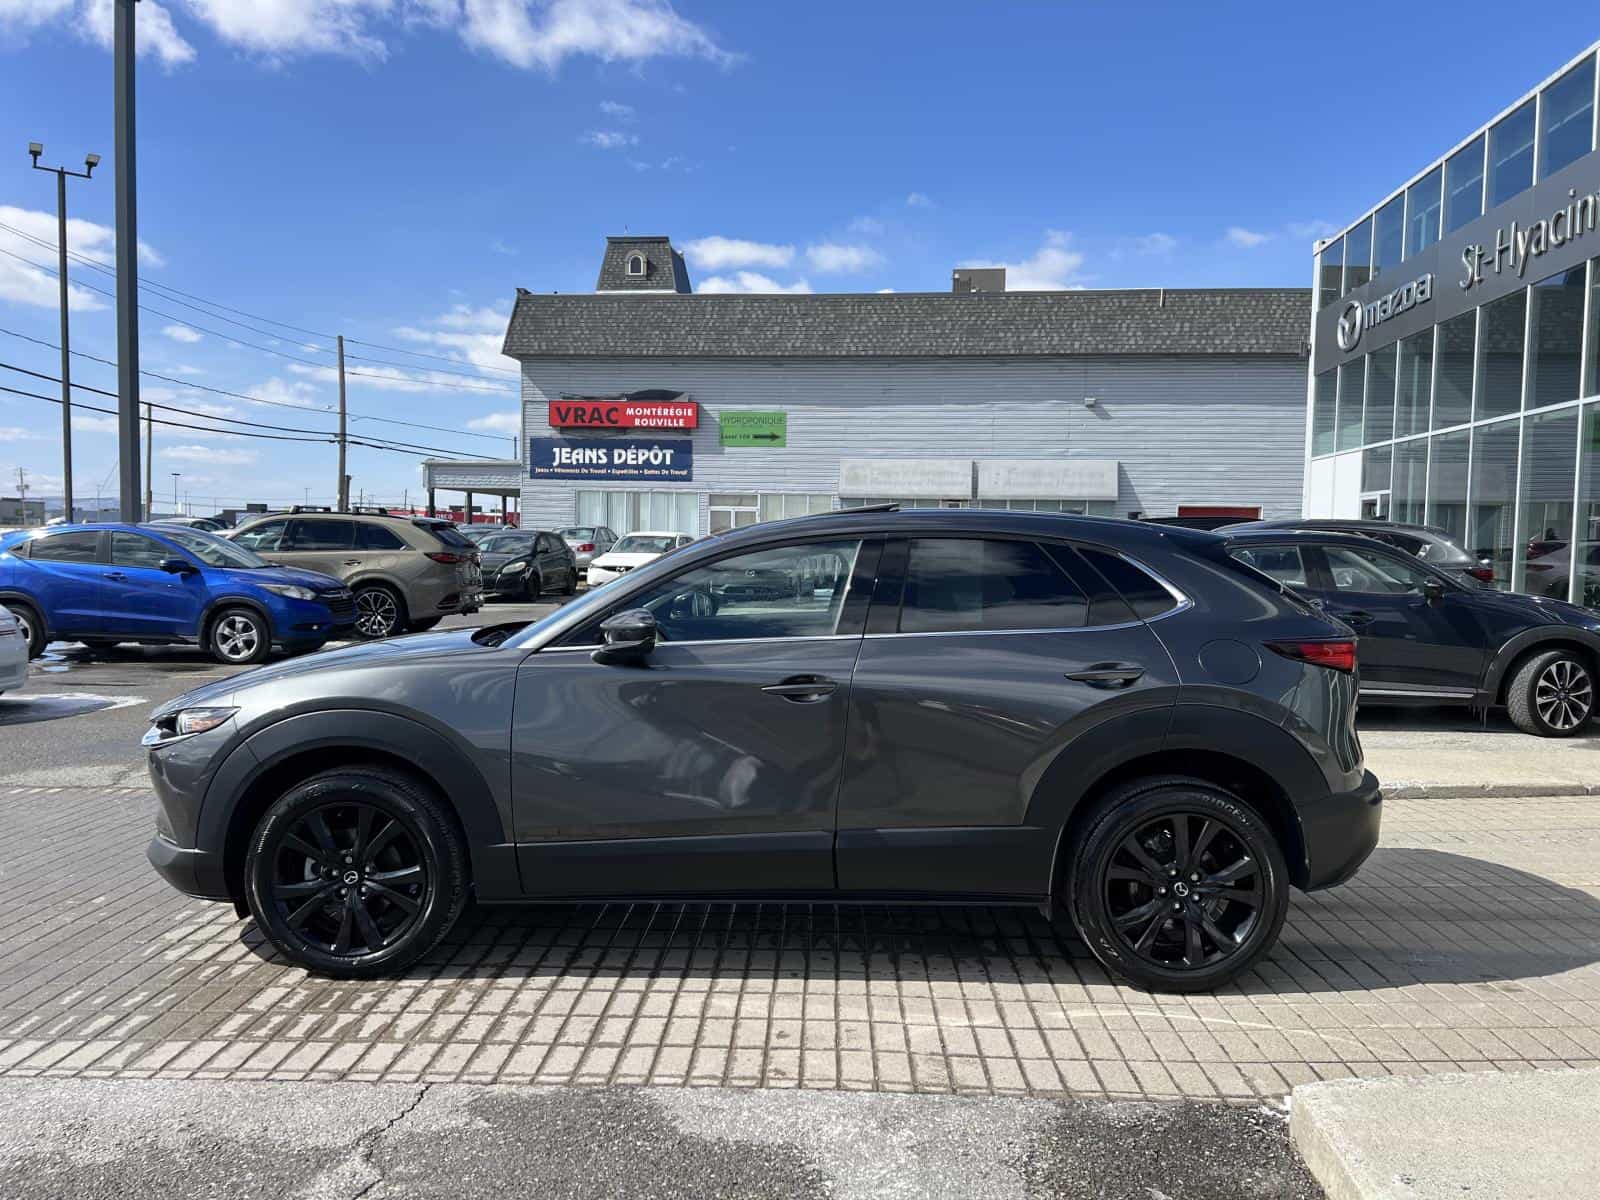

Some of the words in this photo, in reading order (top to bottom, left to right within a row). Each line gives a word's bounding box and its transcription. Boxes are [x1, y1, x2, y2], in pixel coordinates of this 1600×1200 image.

[1459, 187, 1600, 290] St-Hyacin
[1364, 272, 1434, 329] mazda
[556, 407, 619, 424] VRAC
[626, 406, 693, 416] MONTÉRÉGIE
[634, 418, 685, 426] ROUVILLE
[553, 447, 607, 466] JEANS
[613, 445, 674, 465] DÉPÔT
